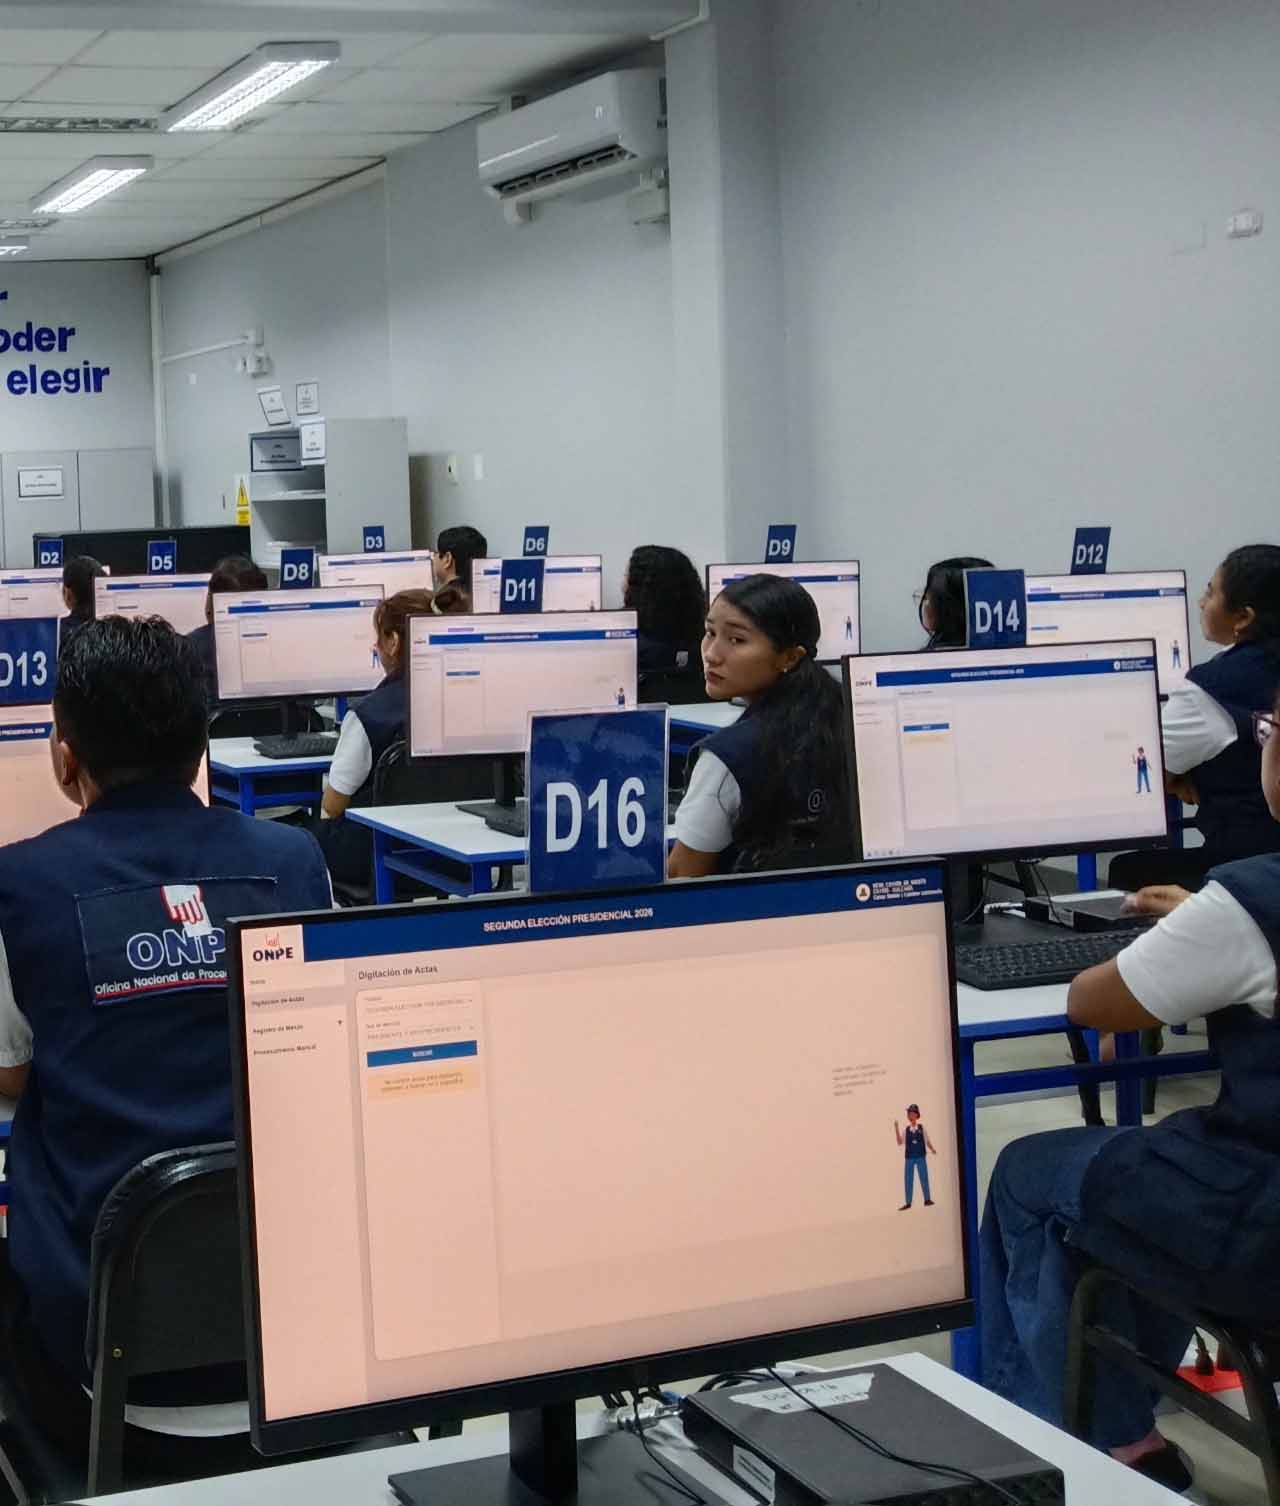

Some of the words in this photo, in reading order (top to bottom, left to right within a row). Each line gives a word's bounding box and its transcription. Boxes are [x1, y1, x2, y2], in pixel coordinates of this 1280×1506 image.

[6, 359, 112, 396] elegir
[365, 536, 383, 549] D3
[525, 537, 546, 552] D6
[768, 539, 791, 556] D9
[40, 551, 60, 565] D2
[151, 555, 174, 571] D5
[1075, 543, 1104, 565] D12
[283, 562, 310, 582] D8
[504, 578, 538, 602] D11
[974, 599, 1022, 634] D14
[546, 776, 647, 853] D16
[483, 919, 527, 932] SEGUNDA
[572, 909, 633, 924] PRESIDENCIAL
[126, 928, 226, 970] ONP
[252, 946, 294, 962] ONPE
[95, 981, 131, 994] Oficina
[133, 972, 180, 988] Nacional
[198, 968, 227, 979] Proce
[358, 967, 401, 981] Digitación
[402, 967, 413, 976] de
[414, 965, 439, 974] Actas
